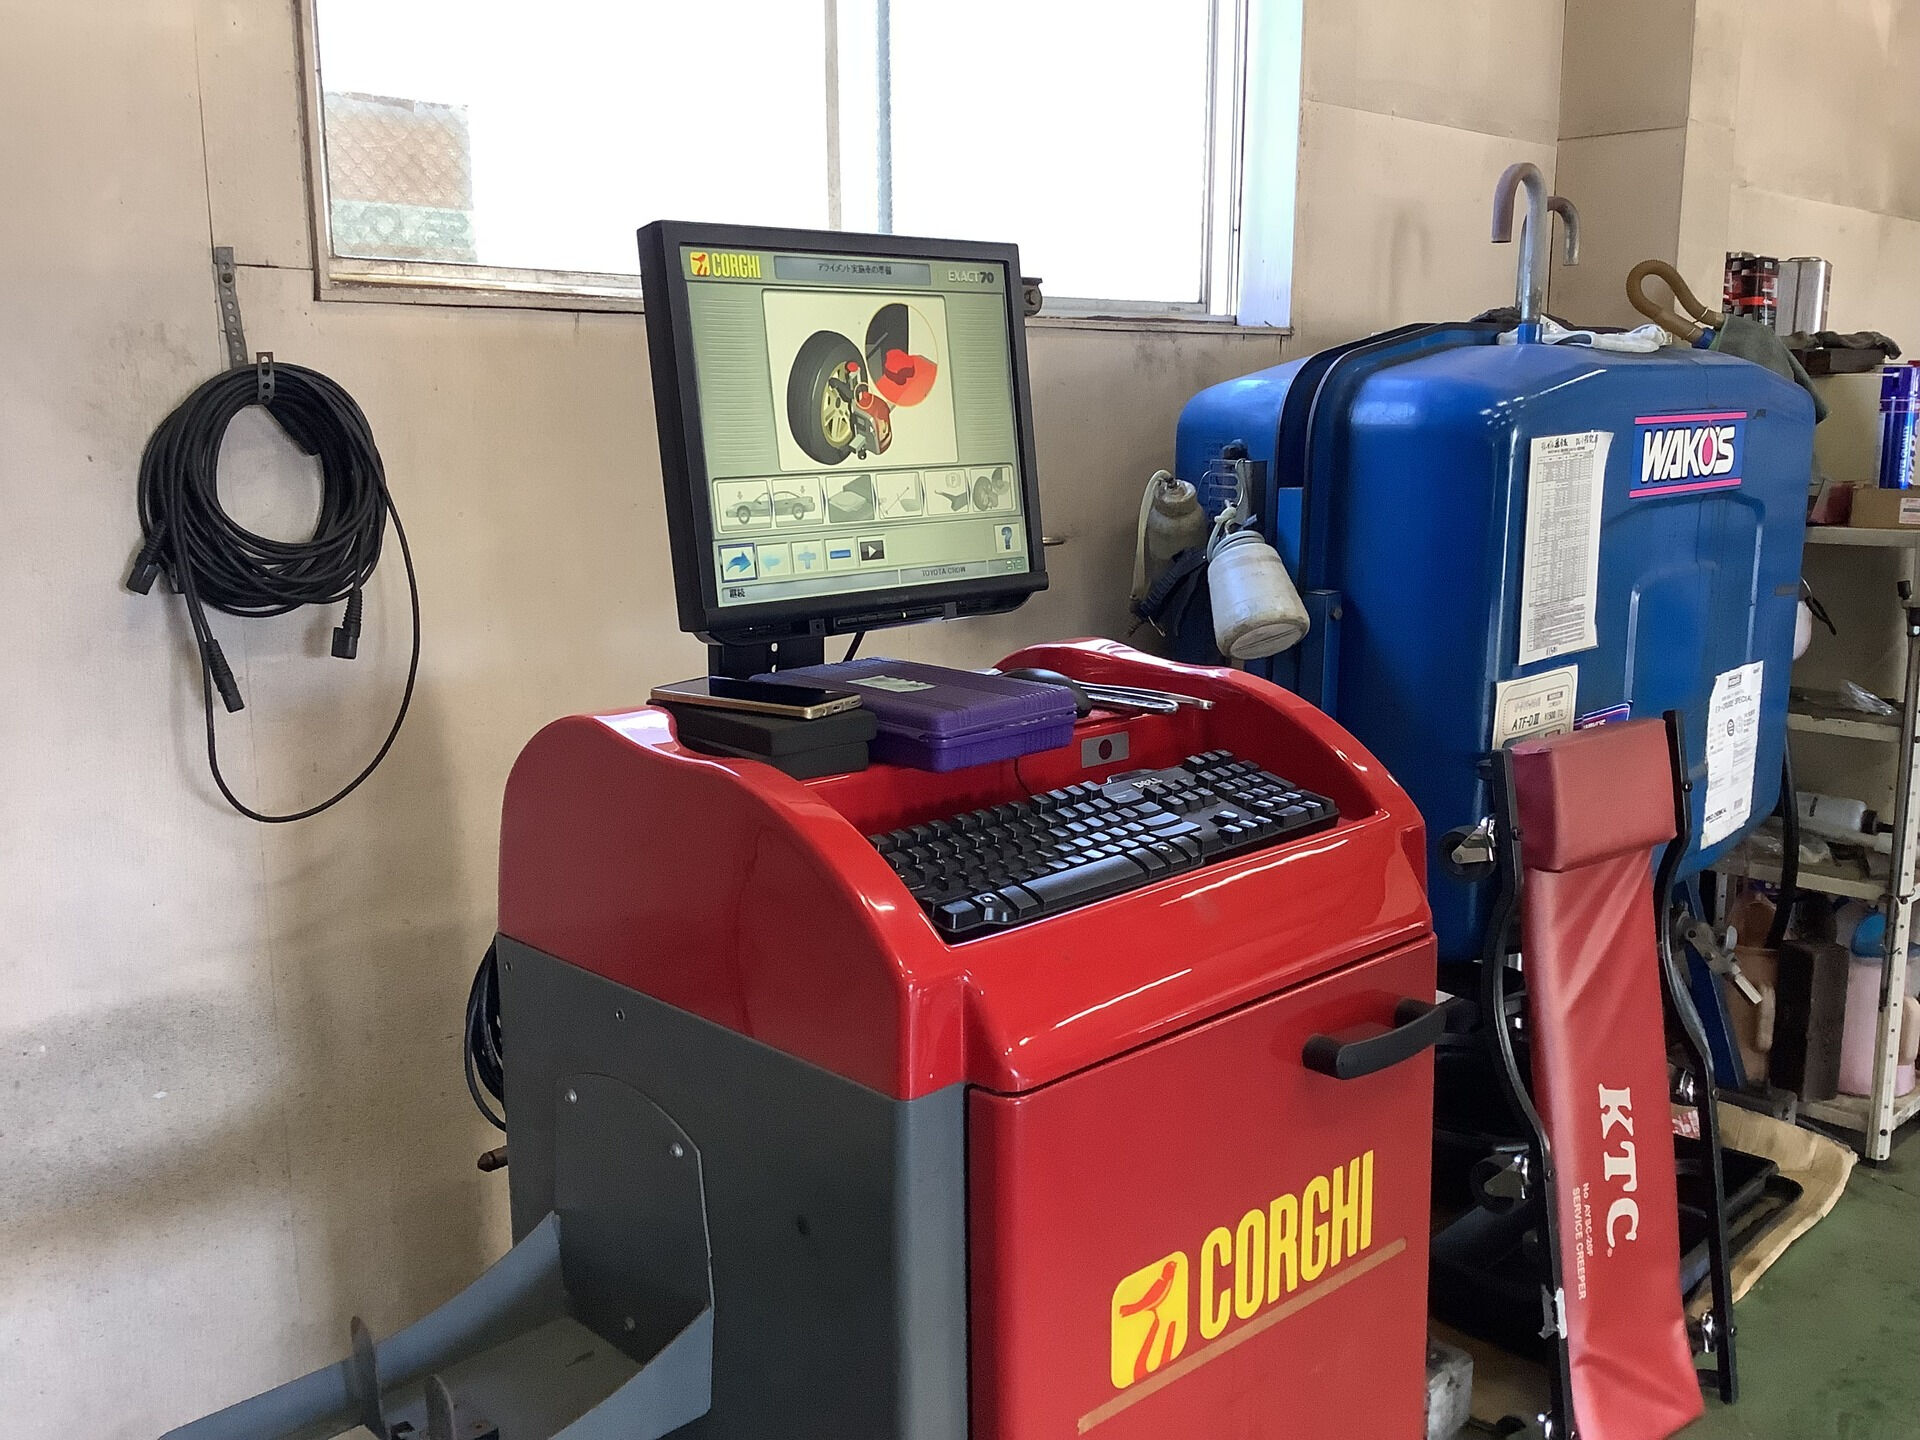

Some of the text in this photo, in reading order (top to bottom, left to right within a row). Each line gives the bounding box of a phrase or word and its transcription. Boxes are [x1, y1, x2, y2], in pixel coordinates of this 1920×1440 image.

[711, 252, 762, 279] CORGHI
[1641, 425, 1736, 483] WAKO'S
[922, 568, 947, 577] TOYOTA
[1131, 777, 1163, 788] DELL
[1598, 1082, 1640, 1249] KTC
[1199, 1149, 1374, 1340] CORGHI
[1572, 1187, 1587, 1300] SERVICE CREEPER
